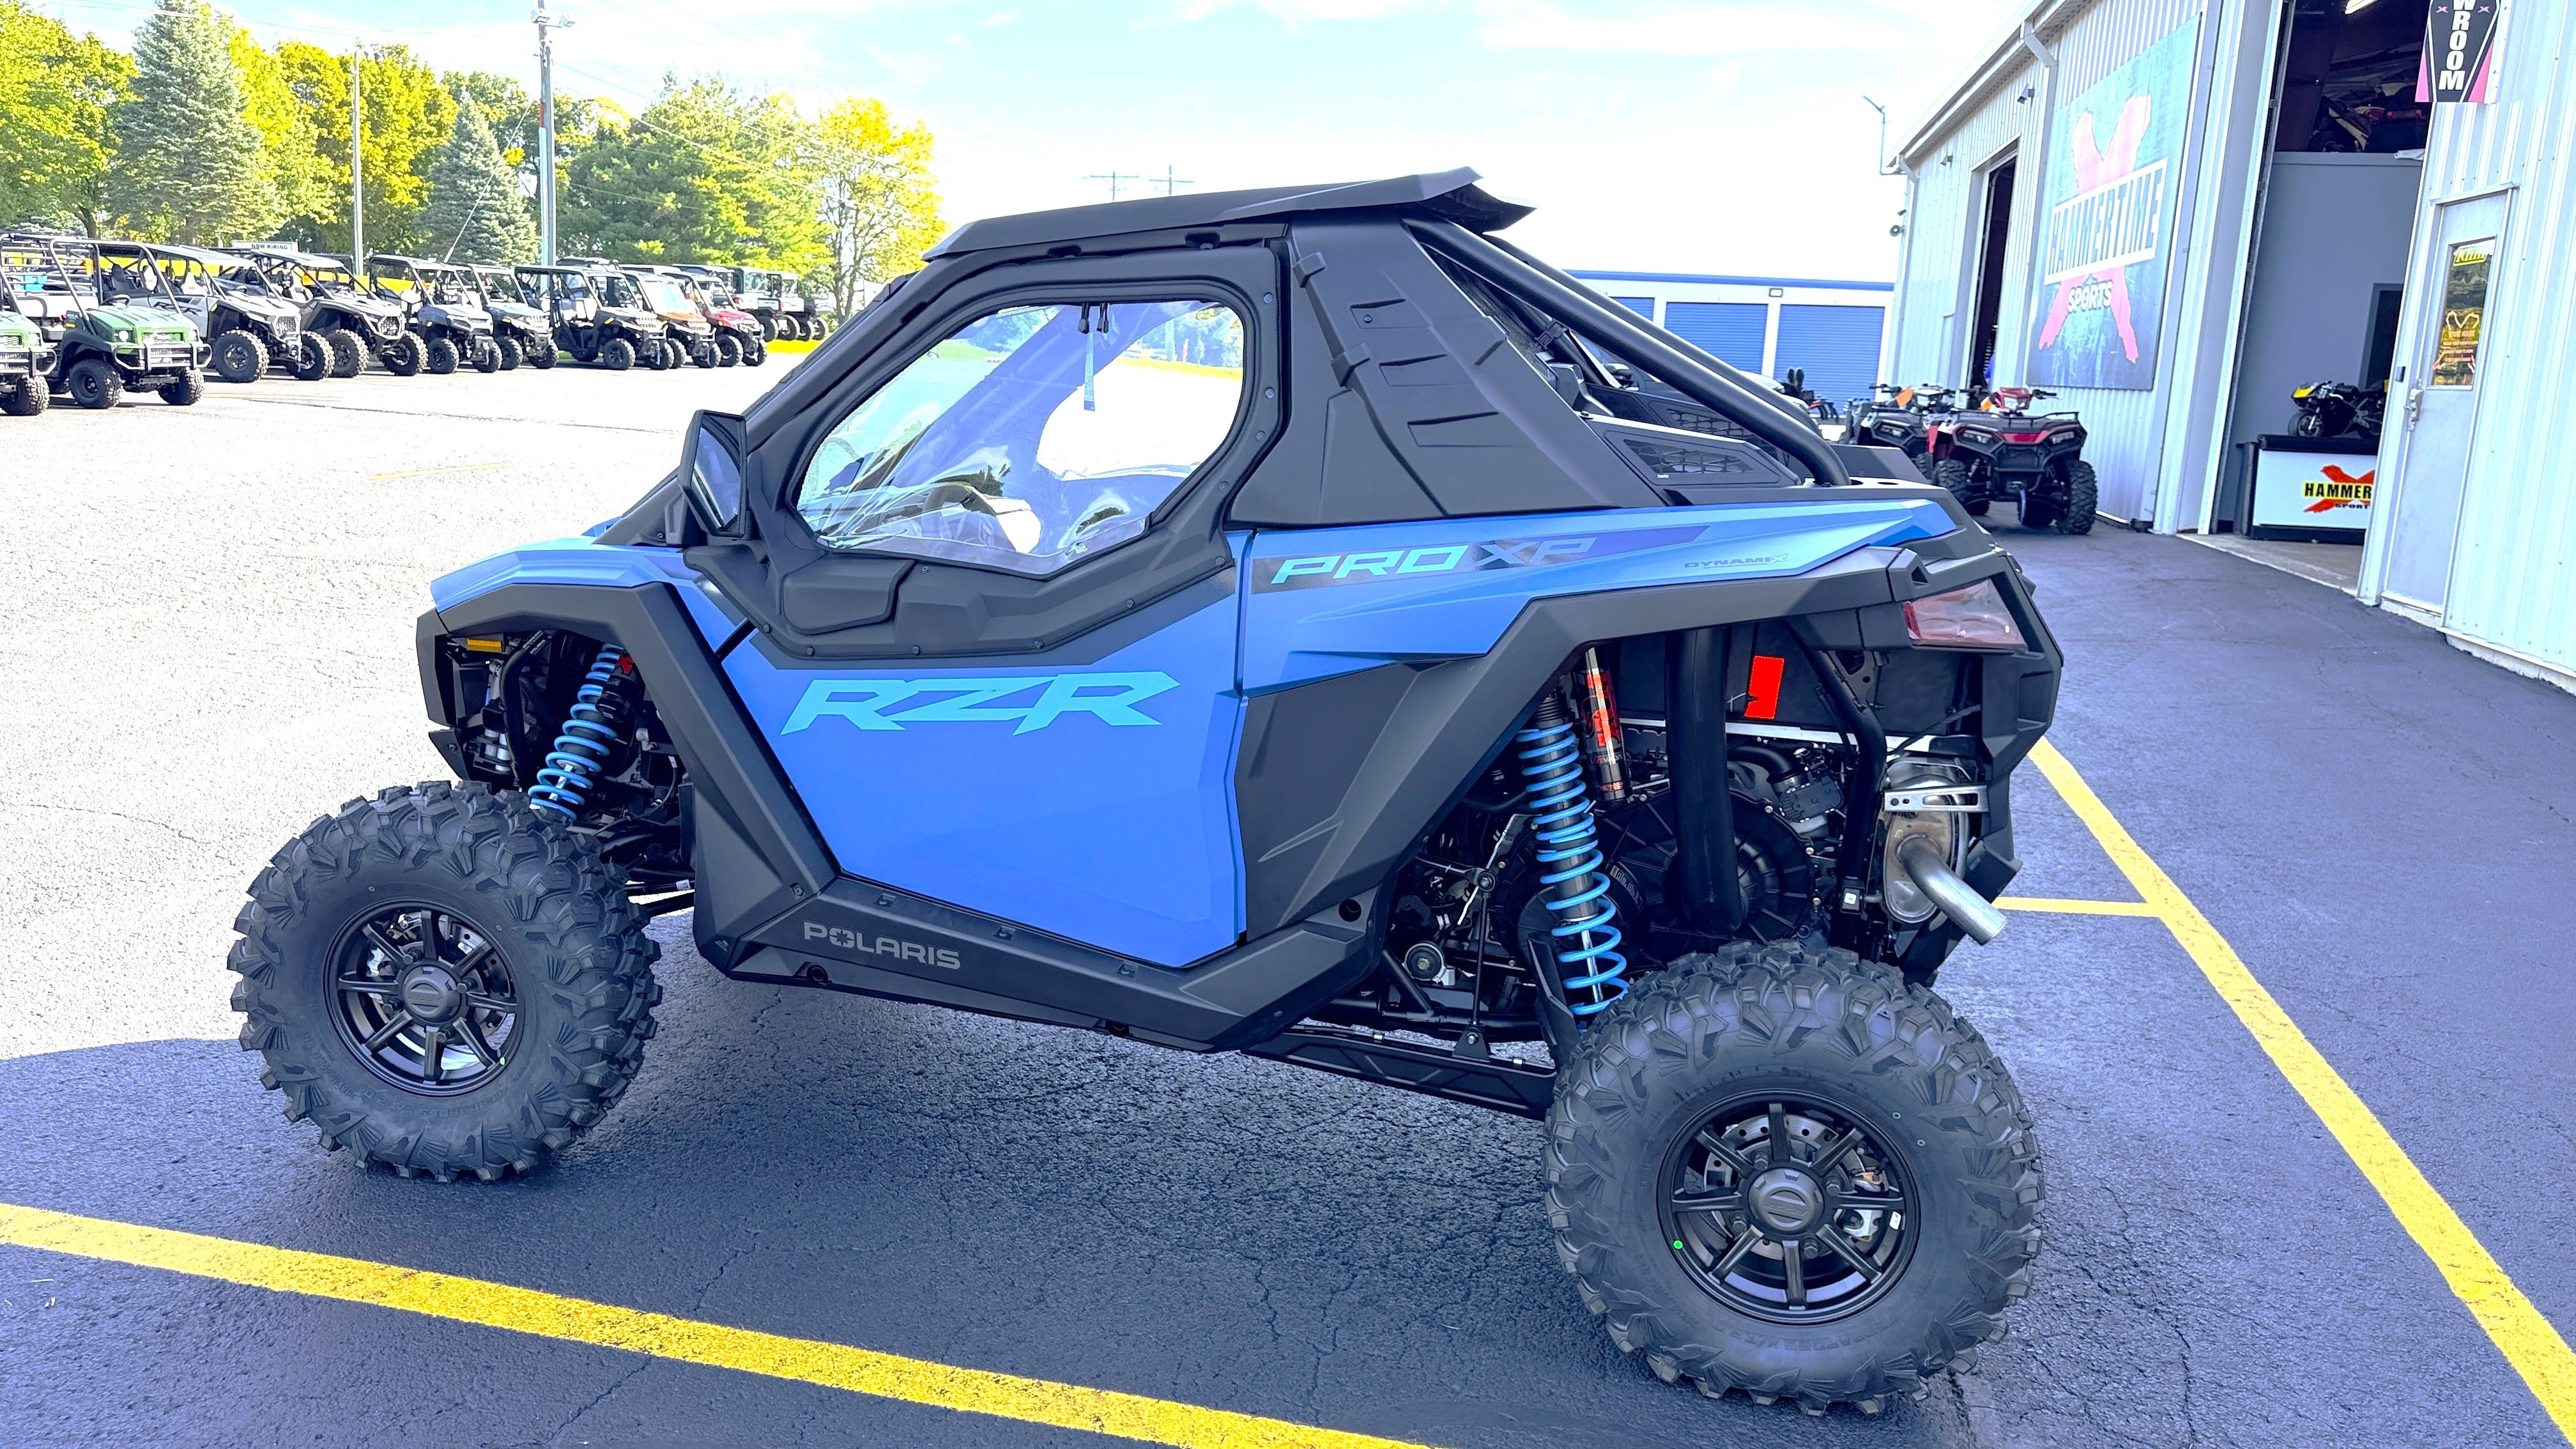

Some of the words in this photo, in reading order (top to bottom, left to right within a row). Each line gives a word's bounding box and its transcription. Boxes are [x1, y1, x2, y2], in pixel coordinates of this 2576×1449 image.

[2048, 167, 2164, 275] HAMMERTIME
[2067, 279, 2113, 313] SPORTS
[1270, 544, 1469, 585] PRO
[1472, 537, 1597, 568] XP
[1684, 553, 1788, 568] DYNAMIX
[779, 671, 1181, 737] RZR
[803, 921, 961, 970] POLARIS
